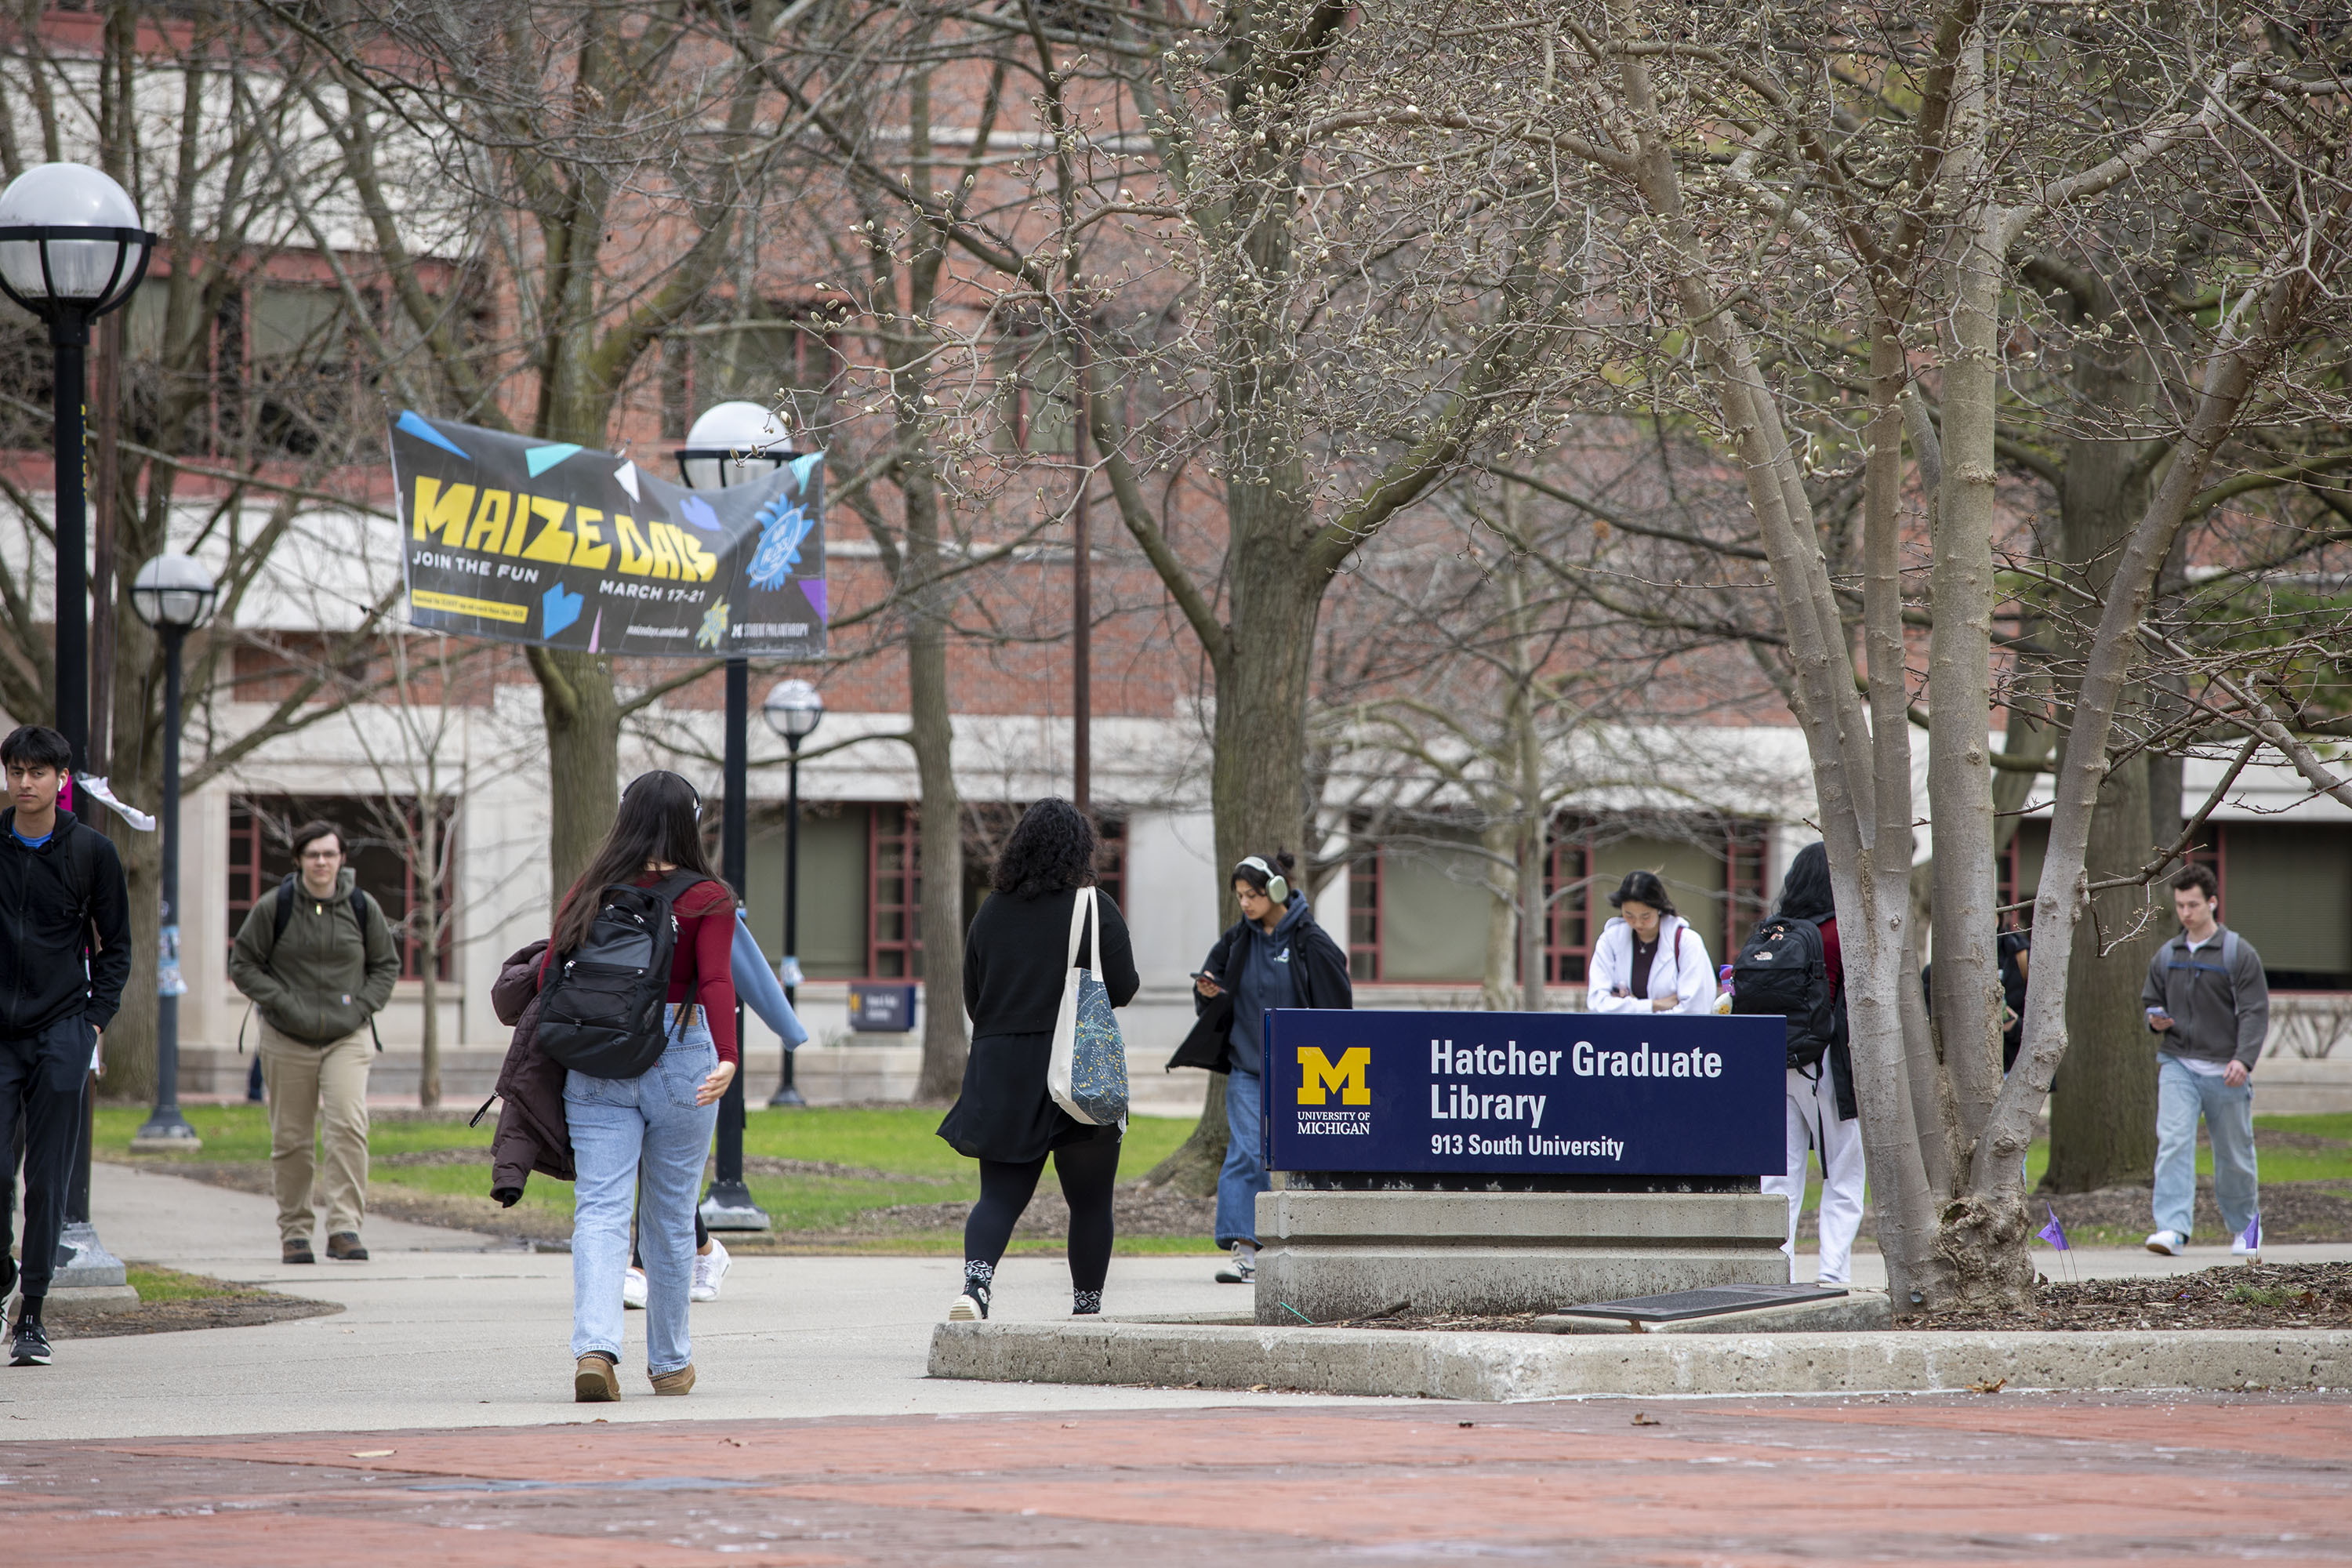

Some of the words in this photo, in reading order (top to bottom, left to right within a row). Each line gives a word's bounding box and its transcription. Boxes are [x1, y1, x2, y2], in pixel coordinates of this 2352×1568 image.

[412, 475, 612, 571] MAIZE
[412, 550, 452, 570] JOIN
[455, 557, 492, 576] THE
[497, 564, 539, 583] FUN
[599, 579, 663, 601] MARCH
[667, 589, 706, 603] 17-21
[1431, 1040, 1562, 1075] Hatcher
[1573, 1040, 1722, 1078] Graduate
[1297, 1111, 1355, 1121] UNIVERSITY
[1357, 1112, 1371, 1121] OF
[1431, 1084, 1547, 1128] Library
[1297, 1121, 1370, 1135] MICHIGAN
[1431, 1134, 1463, 1155] 913
[1468, 1134, 1523, 1156] South
[1528, 1134, 1624, 1160] University
